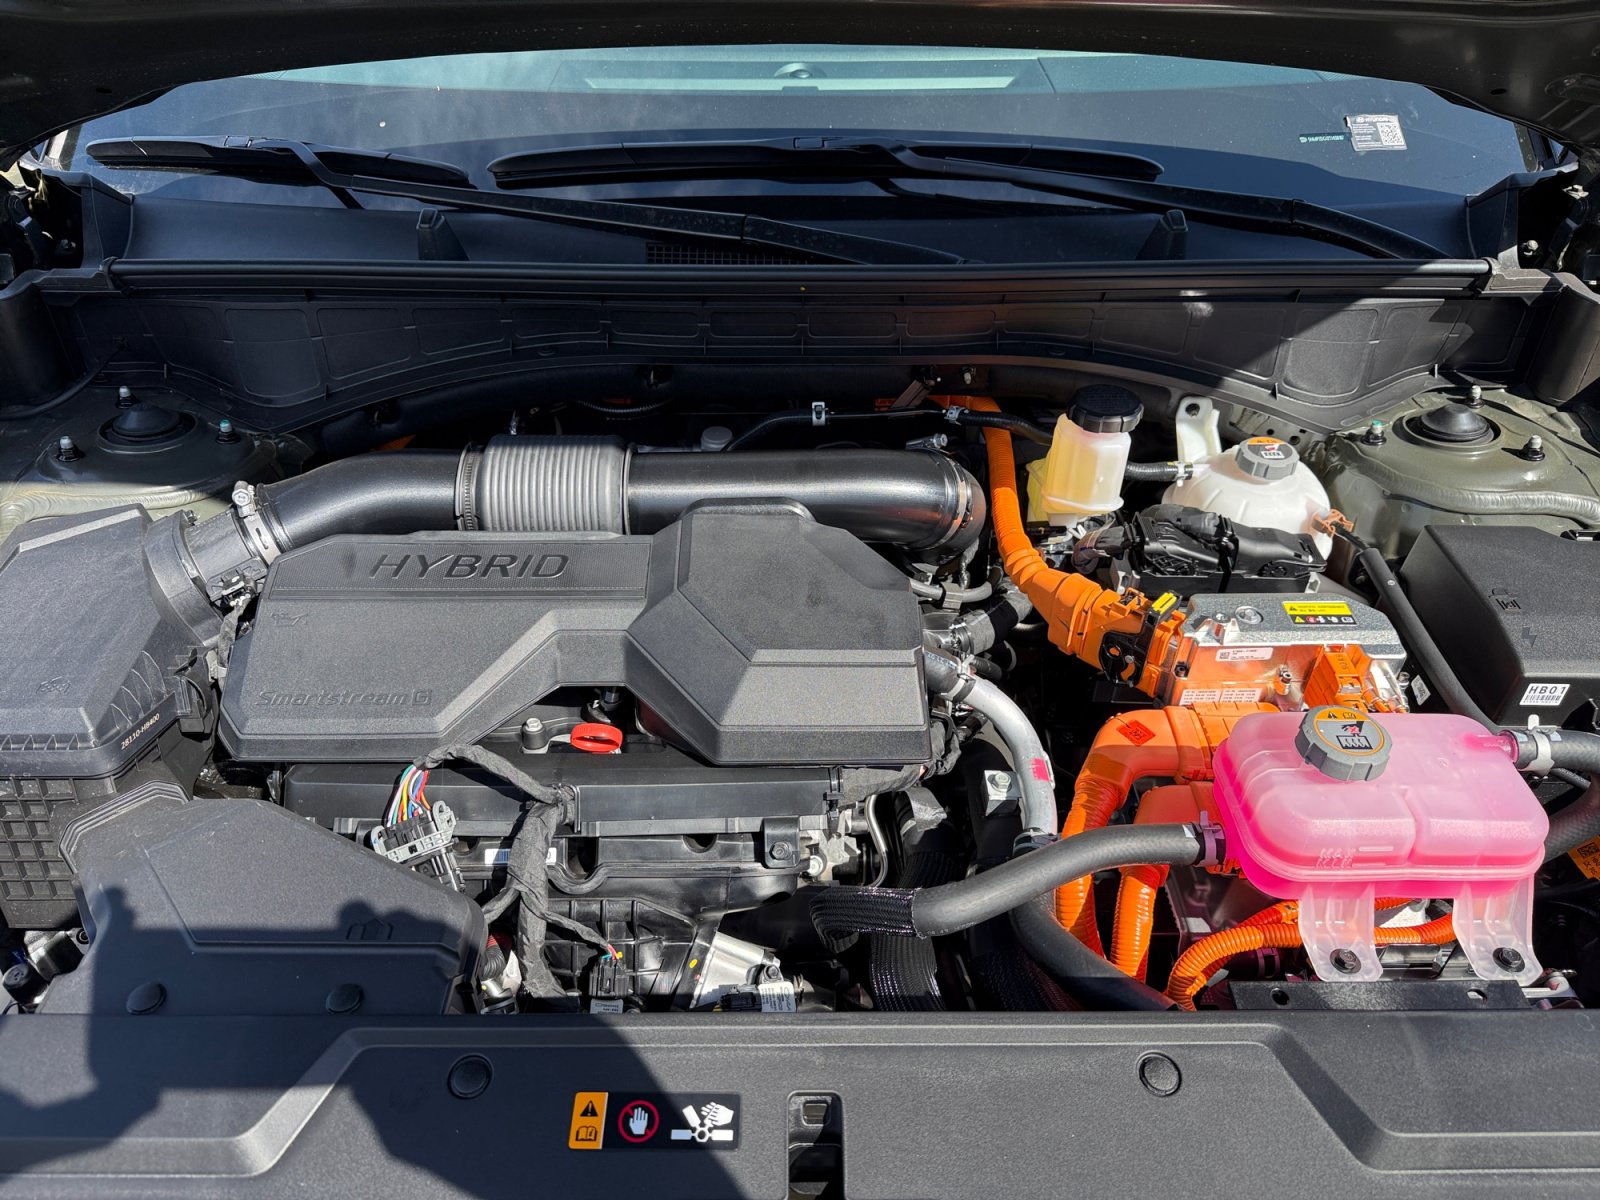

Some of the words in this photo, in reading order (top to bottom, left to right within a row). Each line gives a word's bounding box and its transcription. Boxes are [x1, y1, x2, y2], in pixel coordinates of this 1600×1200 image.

[369, 554, 570, 579] HYBRID
[254, 689, 410, 706] Smartstream
[1528, 685, 1566, 695] HB01
